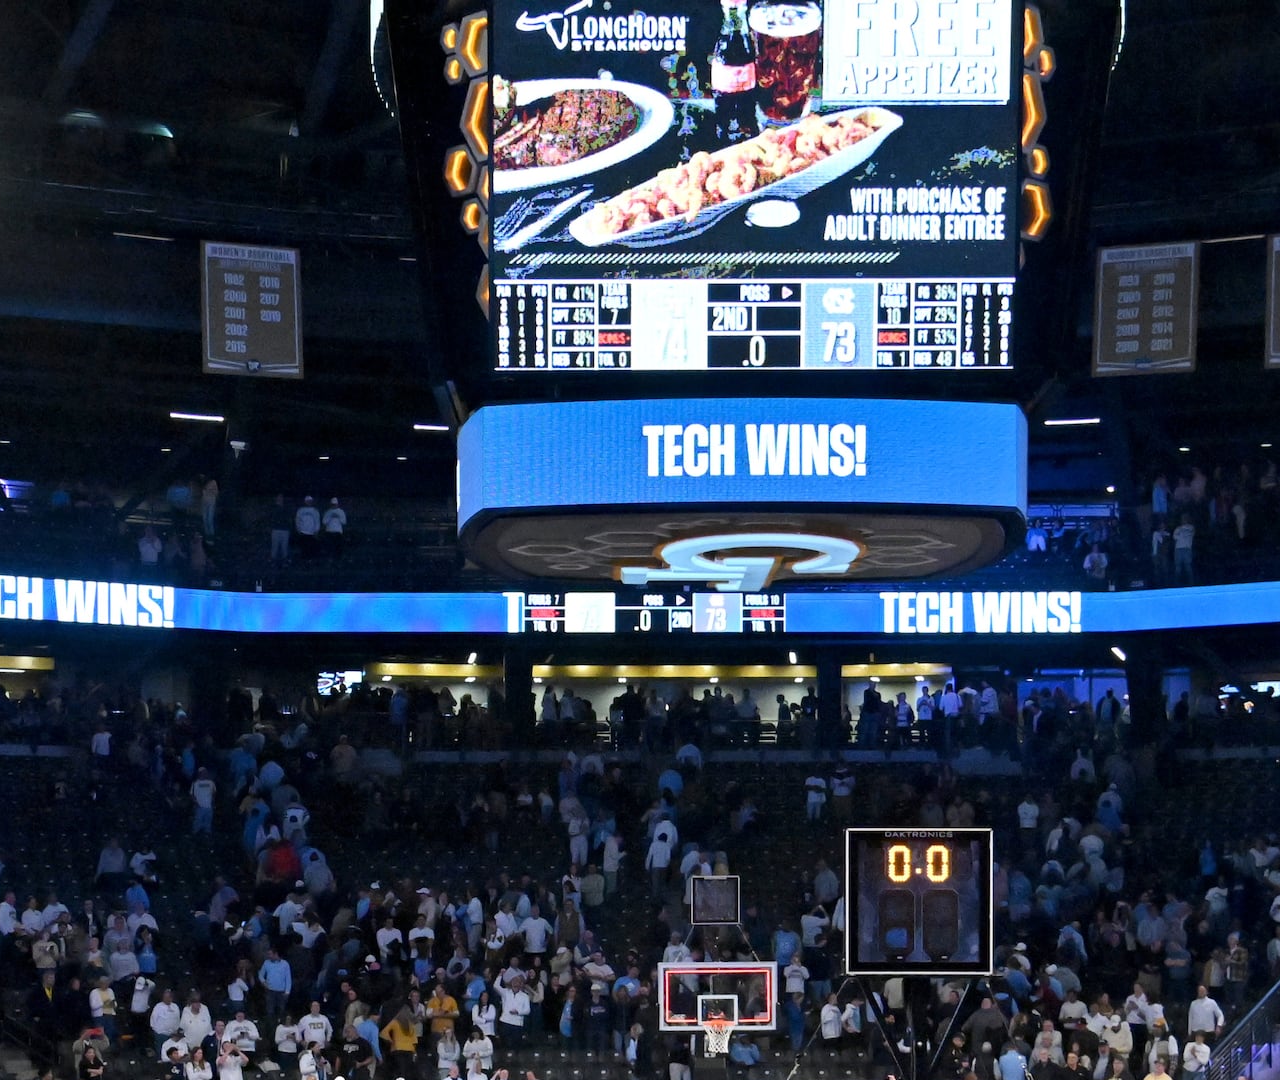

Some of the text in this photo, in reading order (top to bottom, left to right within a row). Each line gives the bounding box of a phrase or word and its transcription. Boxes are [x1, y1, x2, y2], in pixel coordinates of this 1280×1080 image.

[570, 14, 686, 40] LONGHORN
[570, 39, 687, 52] STEAKHOUSE
[840, 62, 998, 95] APPETIZER
[850, 187, 1007, 215] WITH PURCHASE OF
[824, 214, 877, 241] ADULT
[879, 214, 941, 241] DINNER
[573, 286, 593, 300] 41%
[935, 285, 956, 300] 36%
[611, 308, 618, 325] 7
[712, 306, 748, 331] 2ND
[887, 308, 901, 325] 10
[821, 321, 856, 363] 73
[935, 329, 955, 344] 53%
[576, 353, 590, 366] 41
[937, 351, 952, 366] 48
[642, 423, 867, 477] TECH WINS!
[54, 578, 174, 628] WINS!
[771, 594, 781, 605] 10
[705, 608, 727, 631] 73
[879, 592, 1082, 633] TECH WINS!
[884, 831, 954, 839] DAKTRONICS
[888, 844, 950, 883] 0.0
